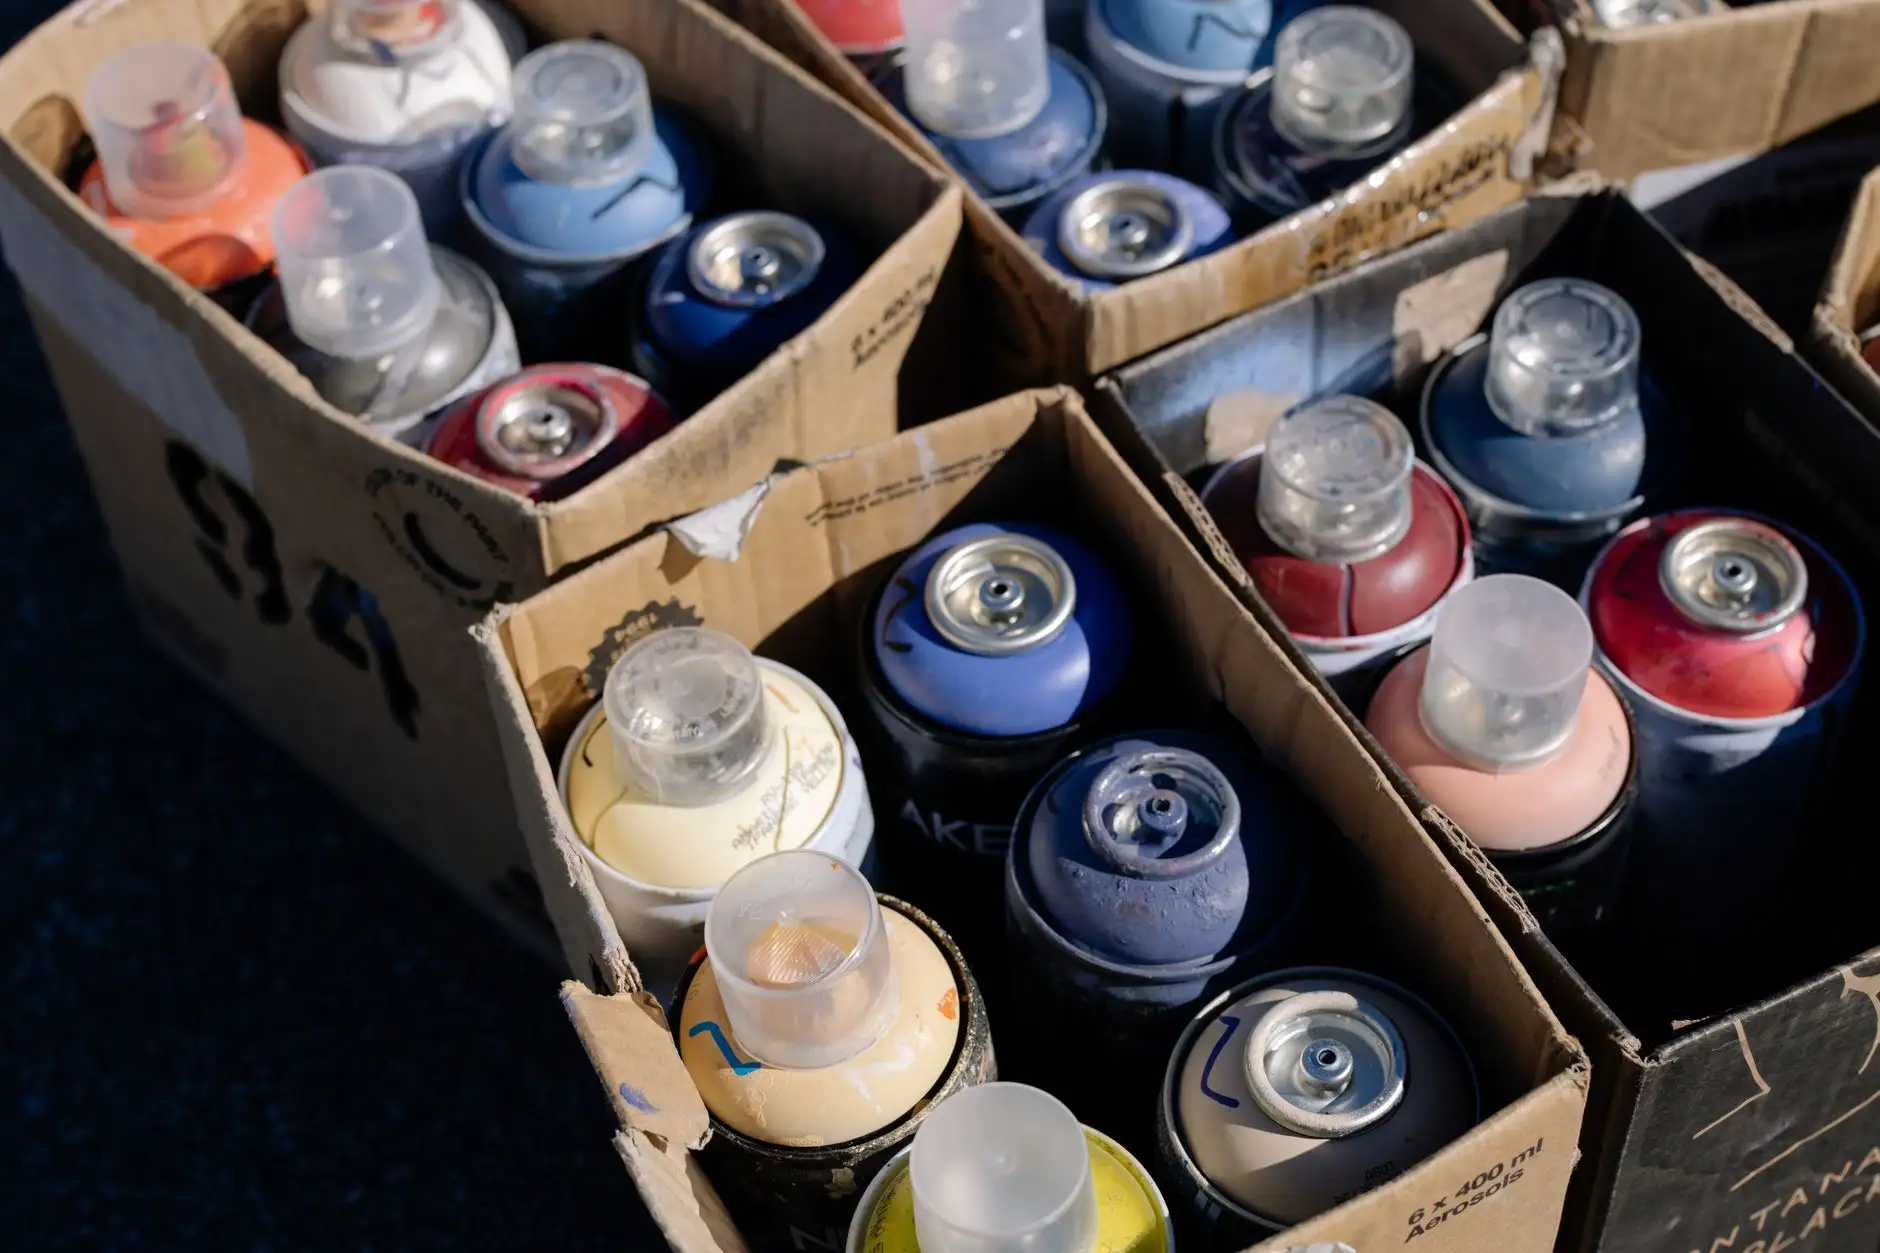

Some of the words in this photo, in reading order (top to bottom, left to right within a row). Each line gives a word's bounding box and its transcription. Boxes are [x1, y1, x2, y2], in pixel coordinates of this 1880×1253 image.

[1404, 1168, 1525, 1244] Aerosols
[1408, 1207, 1425, 1226] 6
[1432, 1196, 1448, 1214] x
[1455, 1162, 1505, 1198] 400
[1510, 1136, 1544, 1168] ml
[1689, 1147, 1880, 1253] NTANA
